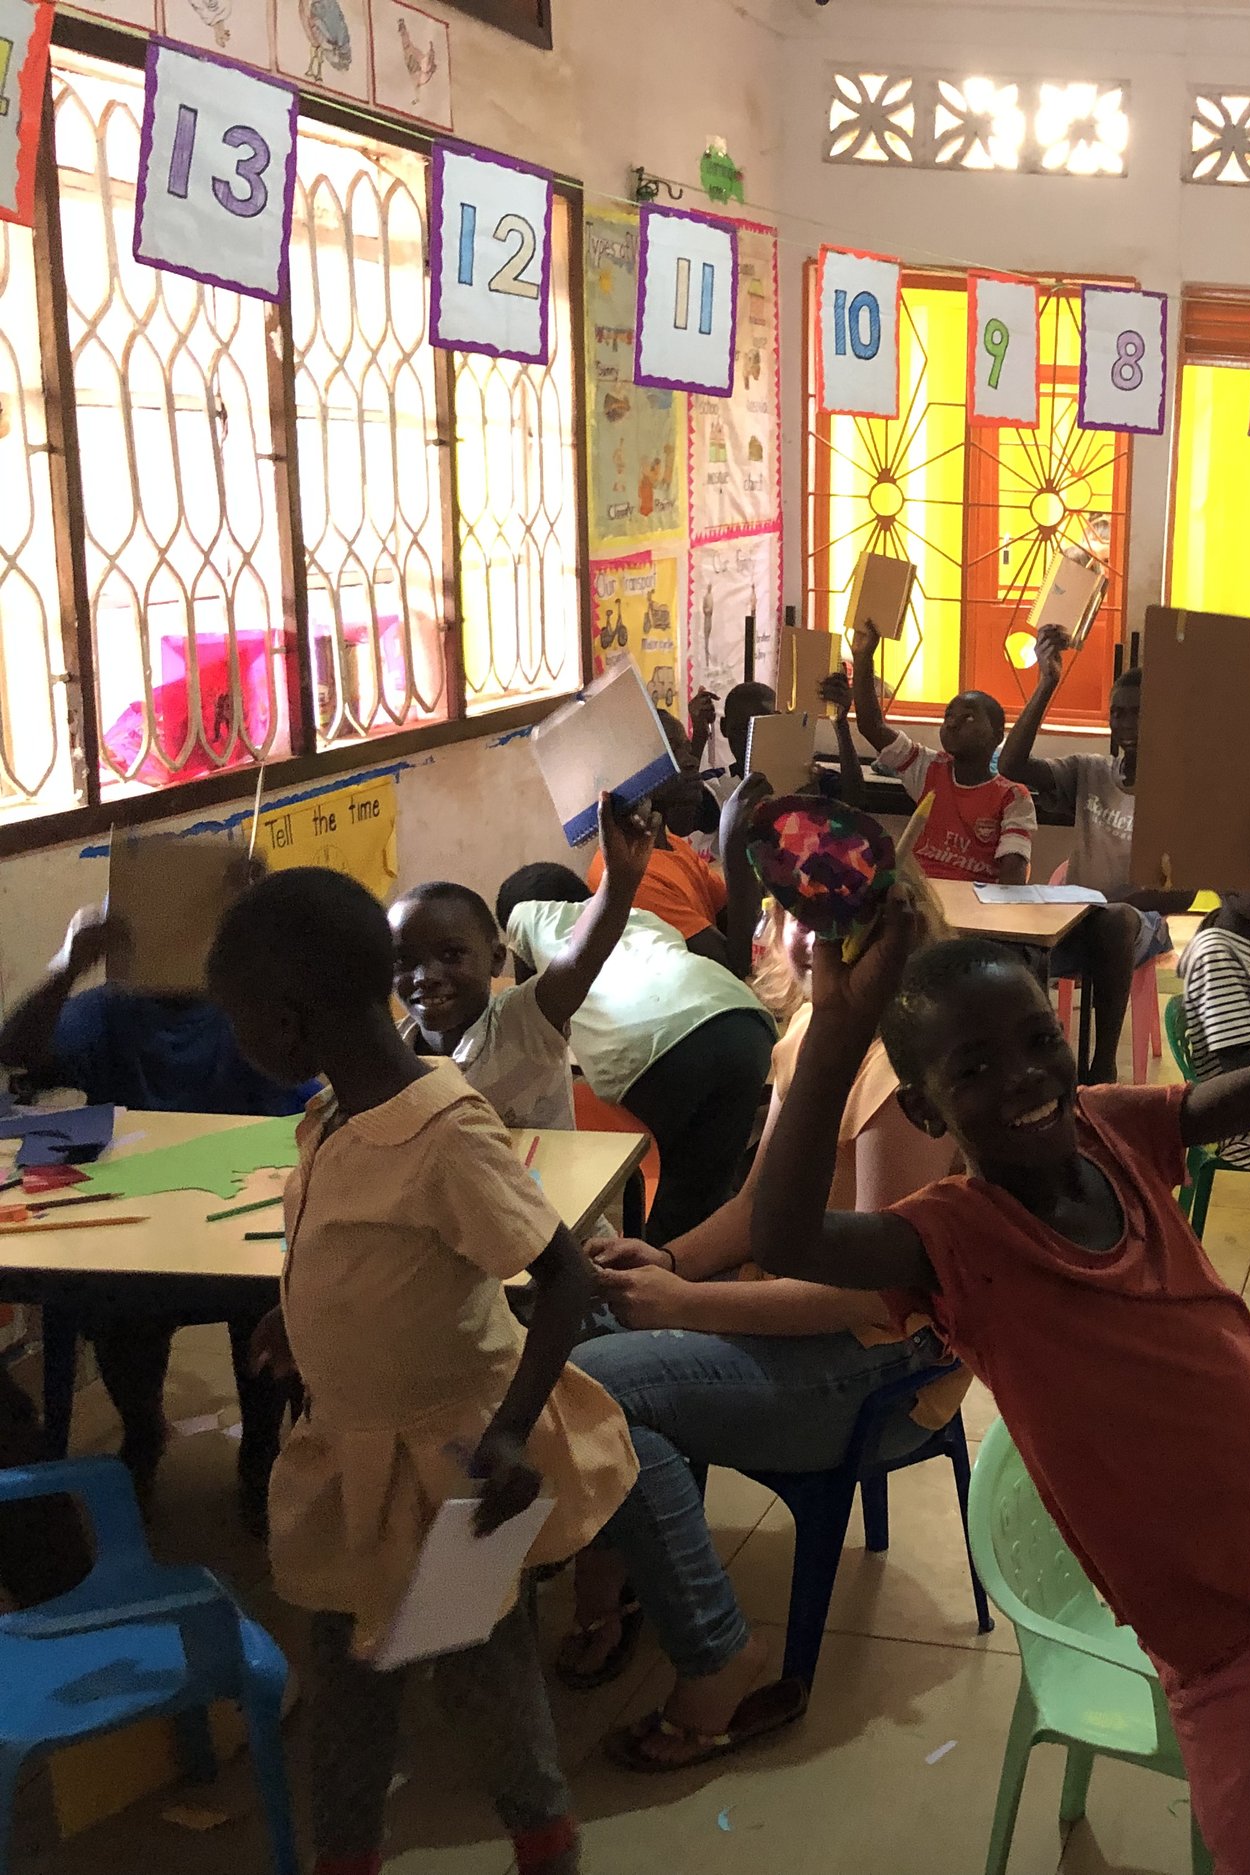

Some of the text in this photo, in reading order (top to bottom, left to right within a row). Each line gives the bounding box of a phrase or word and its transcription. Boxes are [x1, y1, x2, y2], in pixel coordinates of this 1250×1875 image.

[167, 103, 271, 218] 13
[458, 202, 540, 300] 12
[674, 257, 715, 335] 11
[834, 288, 881, 361] 10
[983, 318, 1010, 390] 9
[1110, 329, 1146, 392] 8
[264, 795, 380, 849] Tell the time
